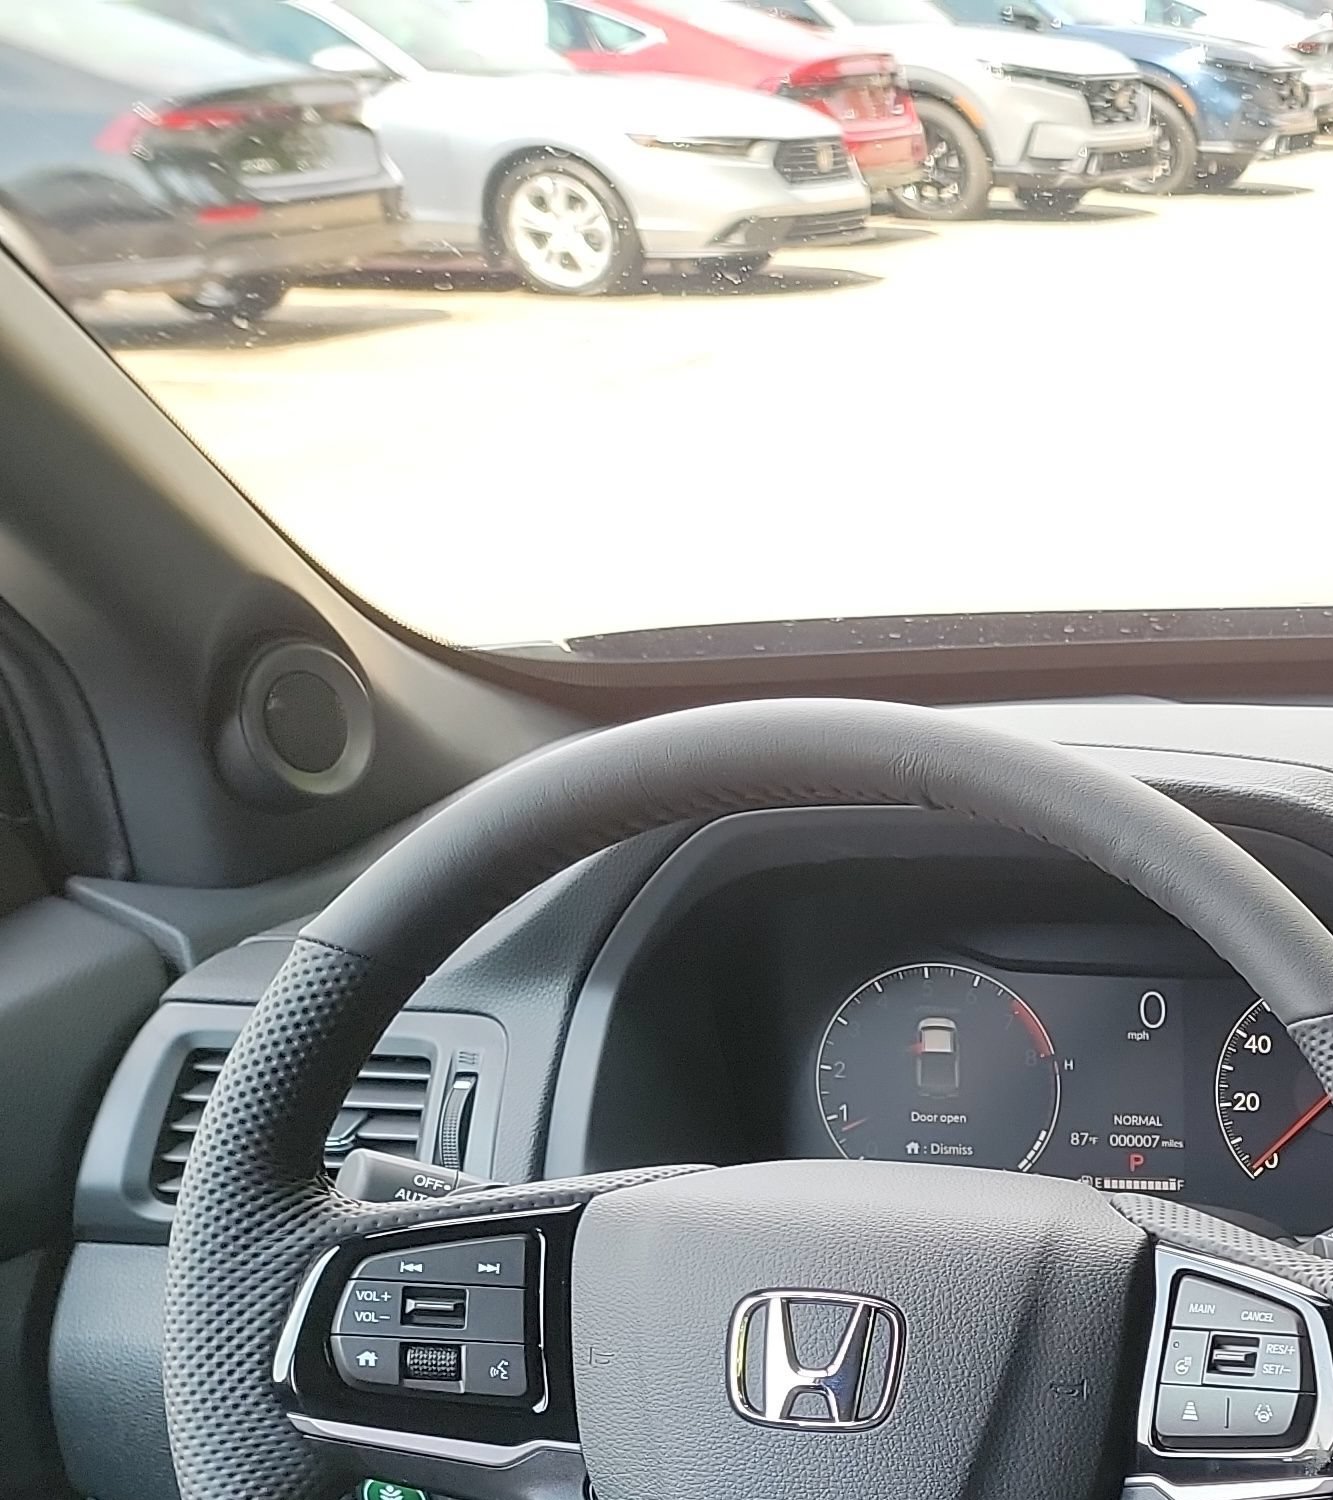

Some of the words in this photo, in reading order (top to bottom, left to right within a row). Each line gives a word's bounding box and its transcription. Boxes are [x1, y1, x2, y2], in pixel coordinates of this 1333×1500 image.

[1139, 991, 1166, 1029] 0
[1127, 1032, 1150, 1042] mph
[1244, 1035, 1272, 1055] 40
[834, 1062, 846, 1078] 2
[1064, 1059, 1074, 1070] H
[1232, 1092, 1260, 1112] 20
[839, 1104, 847, 1122] 1
[911, 1111, 938, 1123] Door
[940, 1113, 967, 1124] open
[1114, 1115, 1163, 1127] NORMAL
[1109, 1134, 1160, 1148] 000007
[1161, 1139, 1184, 1149] miles
[930, 1143, 973, 1156] Dismiss
[1129, 1153, 1144, 1172] P
[414, 1175, 444, 1190] OFF
[1096, 1177, 1103, 1188] E
[1177, 1179, 1184, 1190] F
[1189, 1303, 1216, 1315] MAIN
[1240, 1310, 1274, 1323] CANCEL
